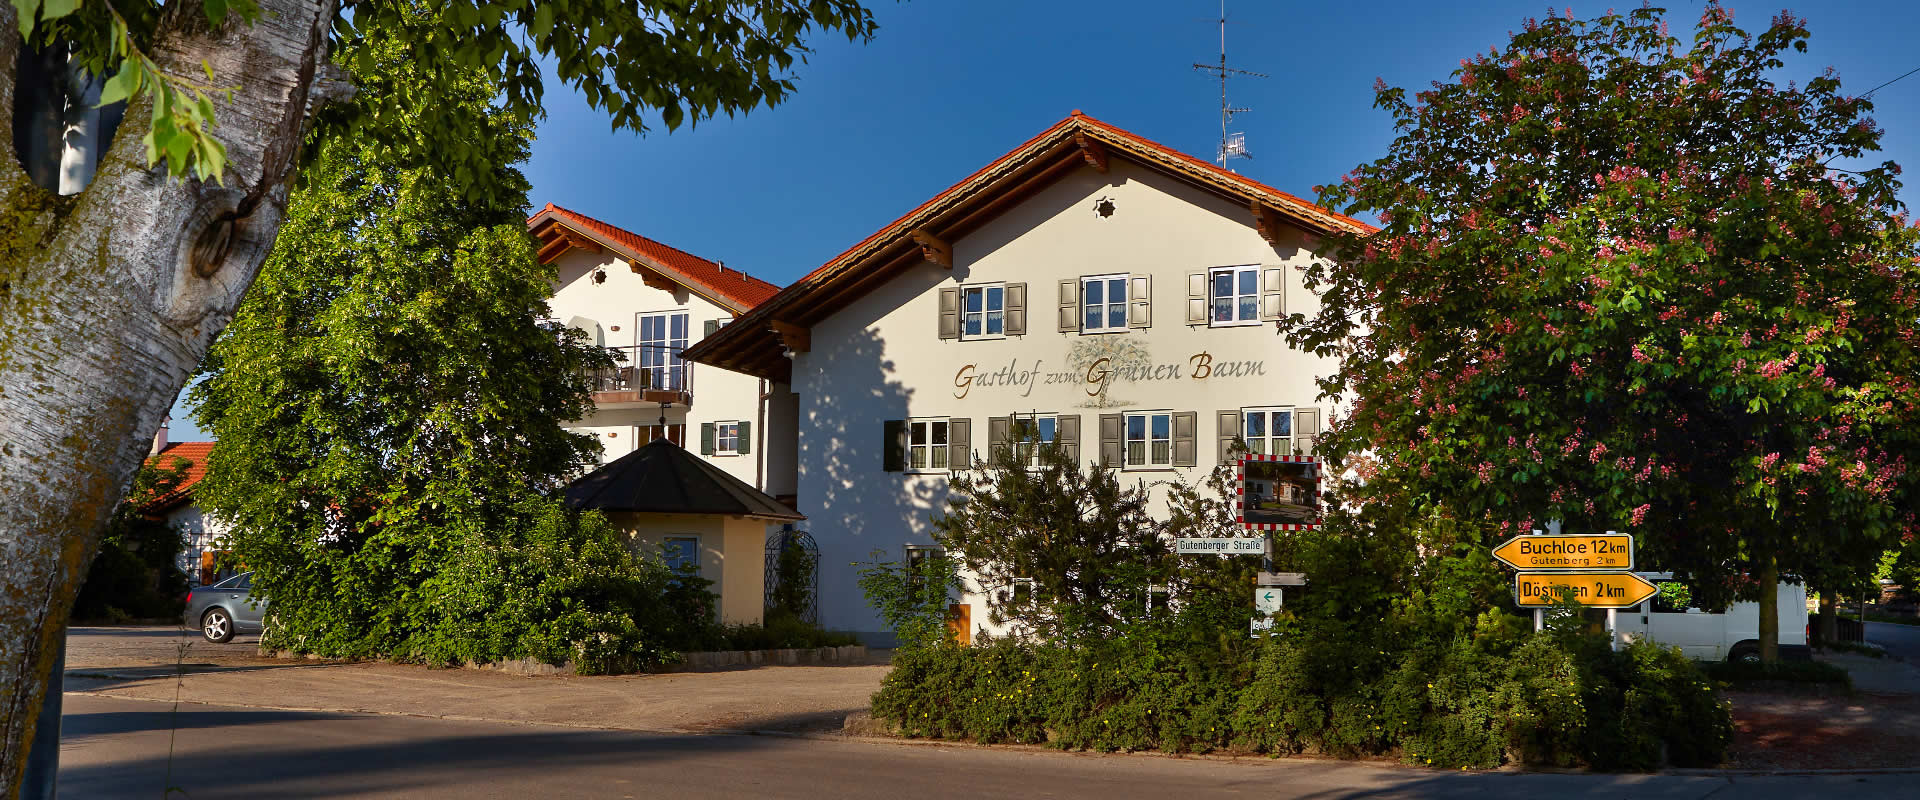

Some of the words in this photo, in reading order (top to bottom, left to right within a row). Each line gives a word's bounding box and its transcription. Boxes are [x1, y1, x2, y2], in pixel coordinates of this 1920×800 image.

[953, 358, 1042, 399] Gasthof
[1044, 371, 1078, 385] zum
[1085, 356, 1182, 397] Grünen
[1189, 350, 1267, 380] Baum
[1180, 541, 1229, 551] Gutenberger
[1233, 541, 1260, 550] Straße
[1520, 540, 1587, 554] Buchloe
[1590, 540, 1608, 554] 12
[1609, 542, 1626, 554] km
[1530, 556, 1590, 566] Gutenberg
[1597, 556, 1603, 564] 2
[1595, 582, 1604, 598] 2
[1606, 584, 1625, 598] km
